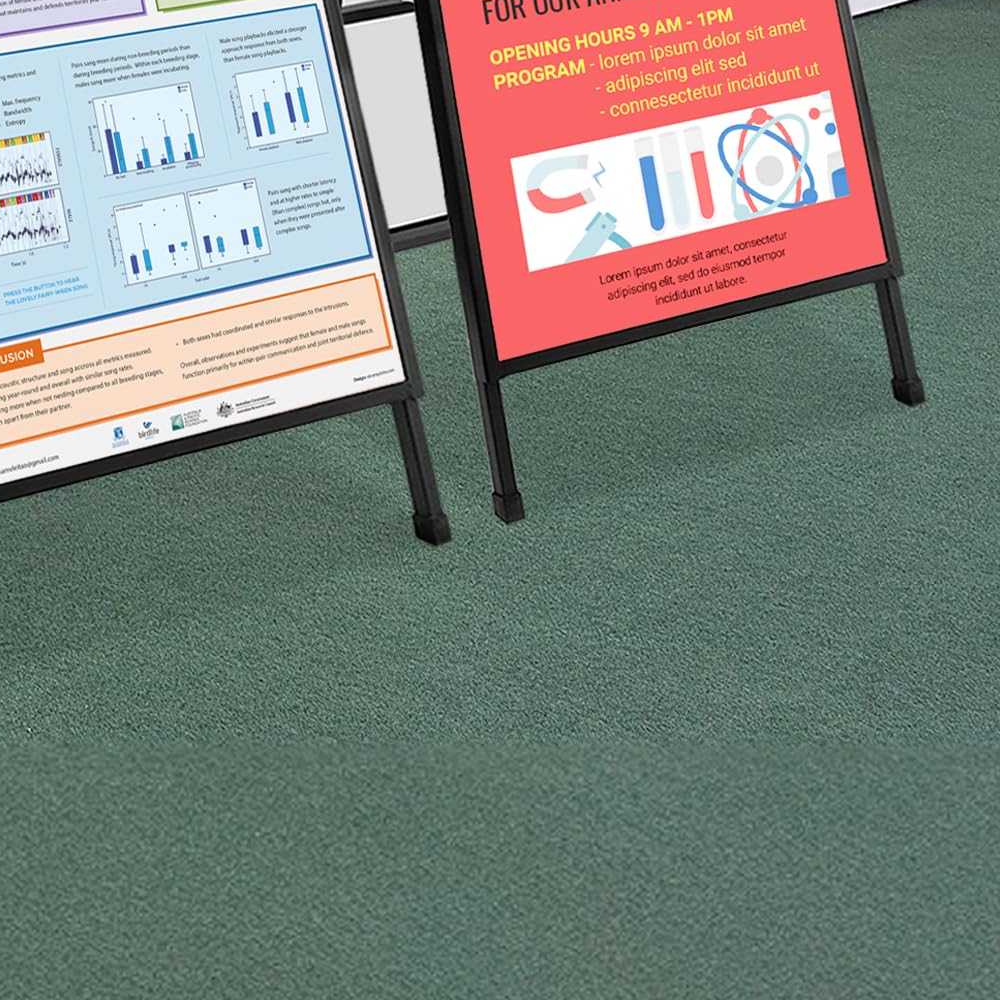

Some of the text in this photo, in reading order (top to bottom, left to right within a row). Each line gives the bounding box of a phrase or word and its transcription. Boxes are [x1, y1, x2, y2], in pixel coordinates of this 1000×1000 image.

[489, 7, 734, 65] OPENING HOURS 9 AM 1PM
[493, 17, 807, 91] PROGRAM lorem ipsum dolor sit amet
[605, 51, 747, 94] adipiscing elit sed
[609, 61, 821, 118] connesectetur incididunt ut
[598, 231, 787, 286] Lorem ipsum dolor sit amet, consectetur
[607, 248, 786, 301] adipiscing elit, sed do eiusmod tempor
[654, 276, 747, 306] incididunt ut labore.
[137, 426, 160, 439] birdlife
